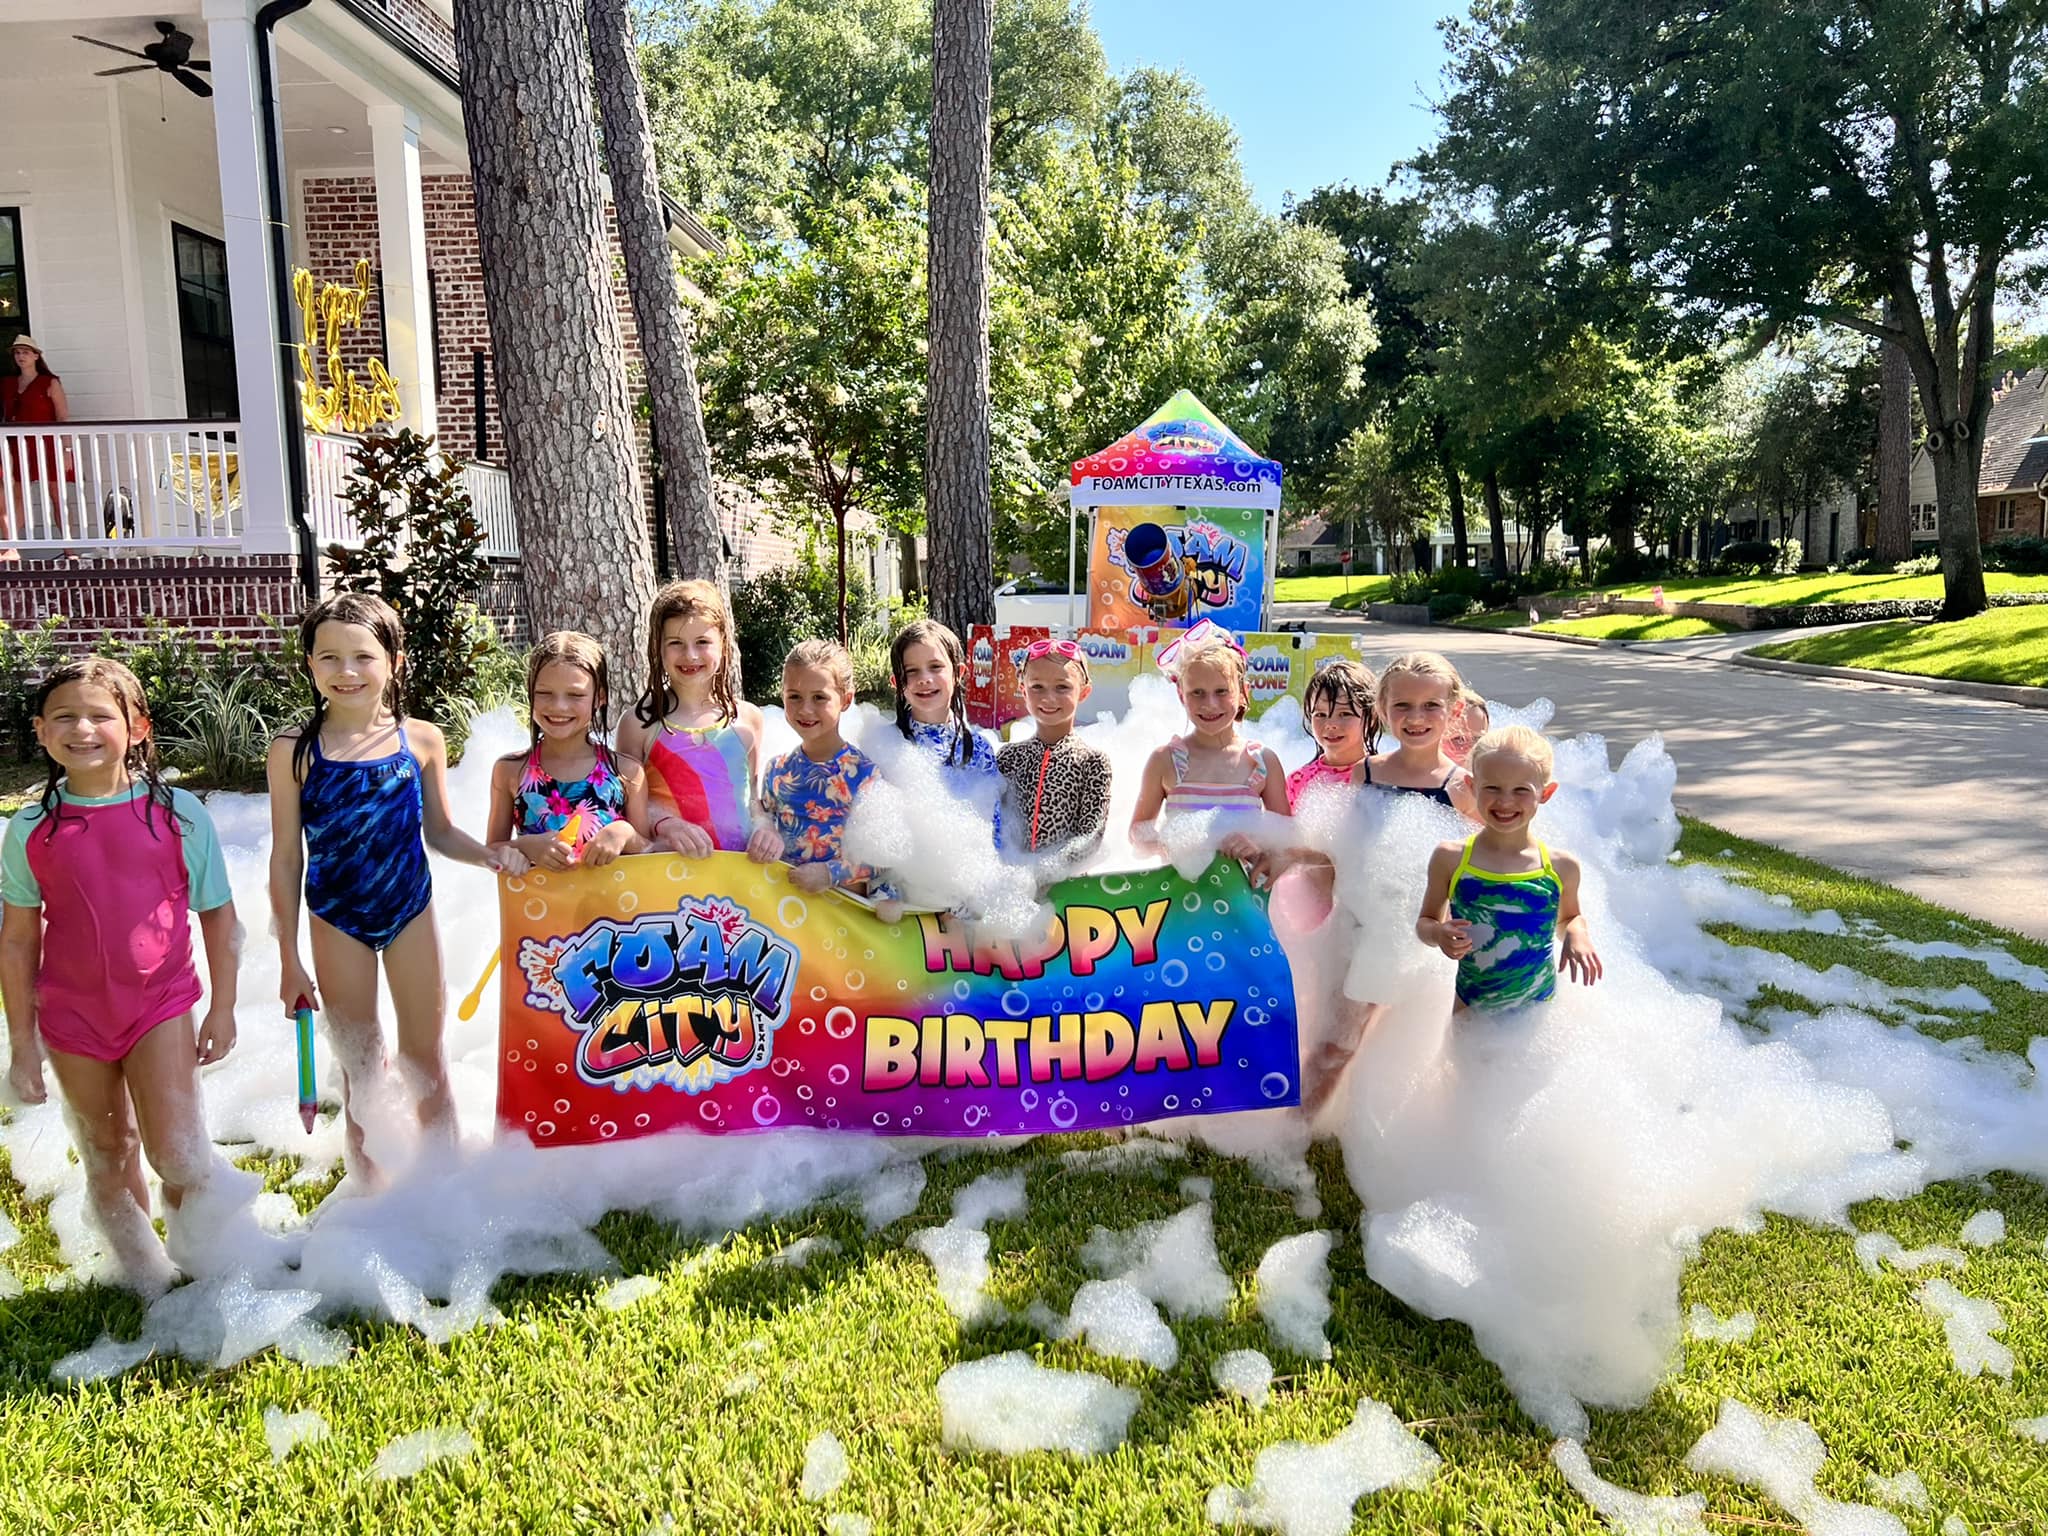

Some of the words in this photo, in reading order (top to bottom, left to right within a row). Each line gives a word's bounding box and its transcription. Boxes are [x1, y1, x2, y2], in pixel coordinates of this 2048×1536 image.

[1093, 475, 1261, 493] FOAMCITYTEXAS.com
[552, 914, 792, 1024] FOAM
[755, 1013, 765, 1061] TEXAS
[861, 999, 1236, 1093] BIRTHDAY
